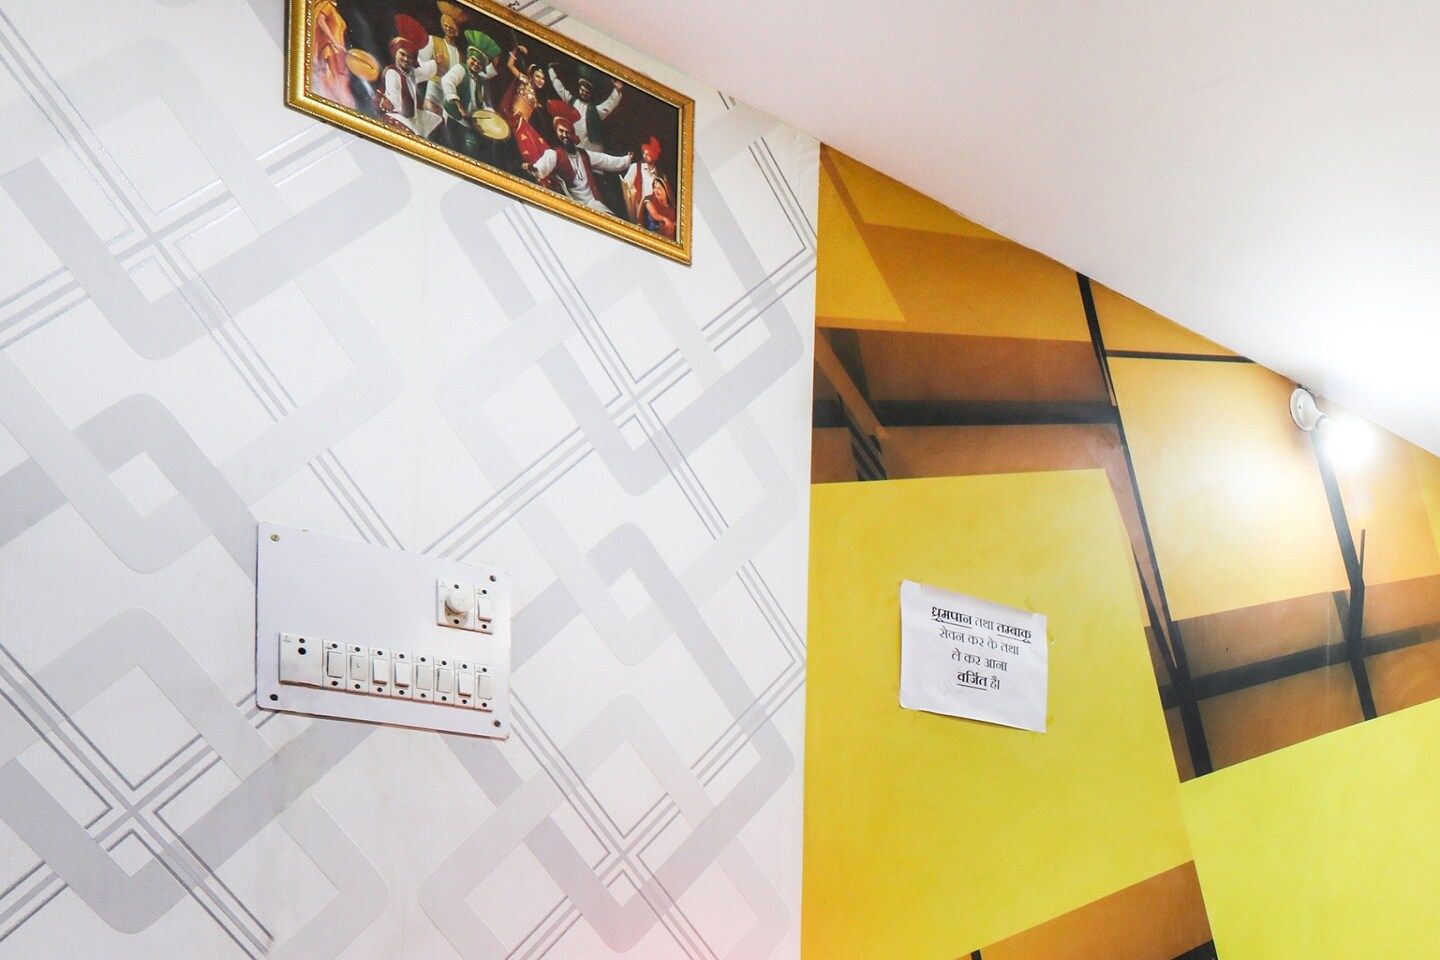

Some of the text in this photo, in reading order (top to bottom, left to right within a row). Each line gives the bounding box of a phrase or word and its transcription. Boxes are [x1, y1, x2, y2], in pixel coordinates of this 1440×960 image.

[975, 617, 994, 630] तथा
[939, 626, 1019, 655] सेवन कर के तथा
[952, 648, 1008, 672] ले कर आना
[957, 670, 988, 687] वर्जित
